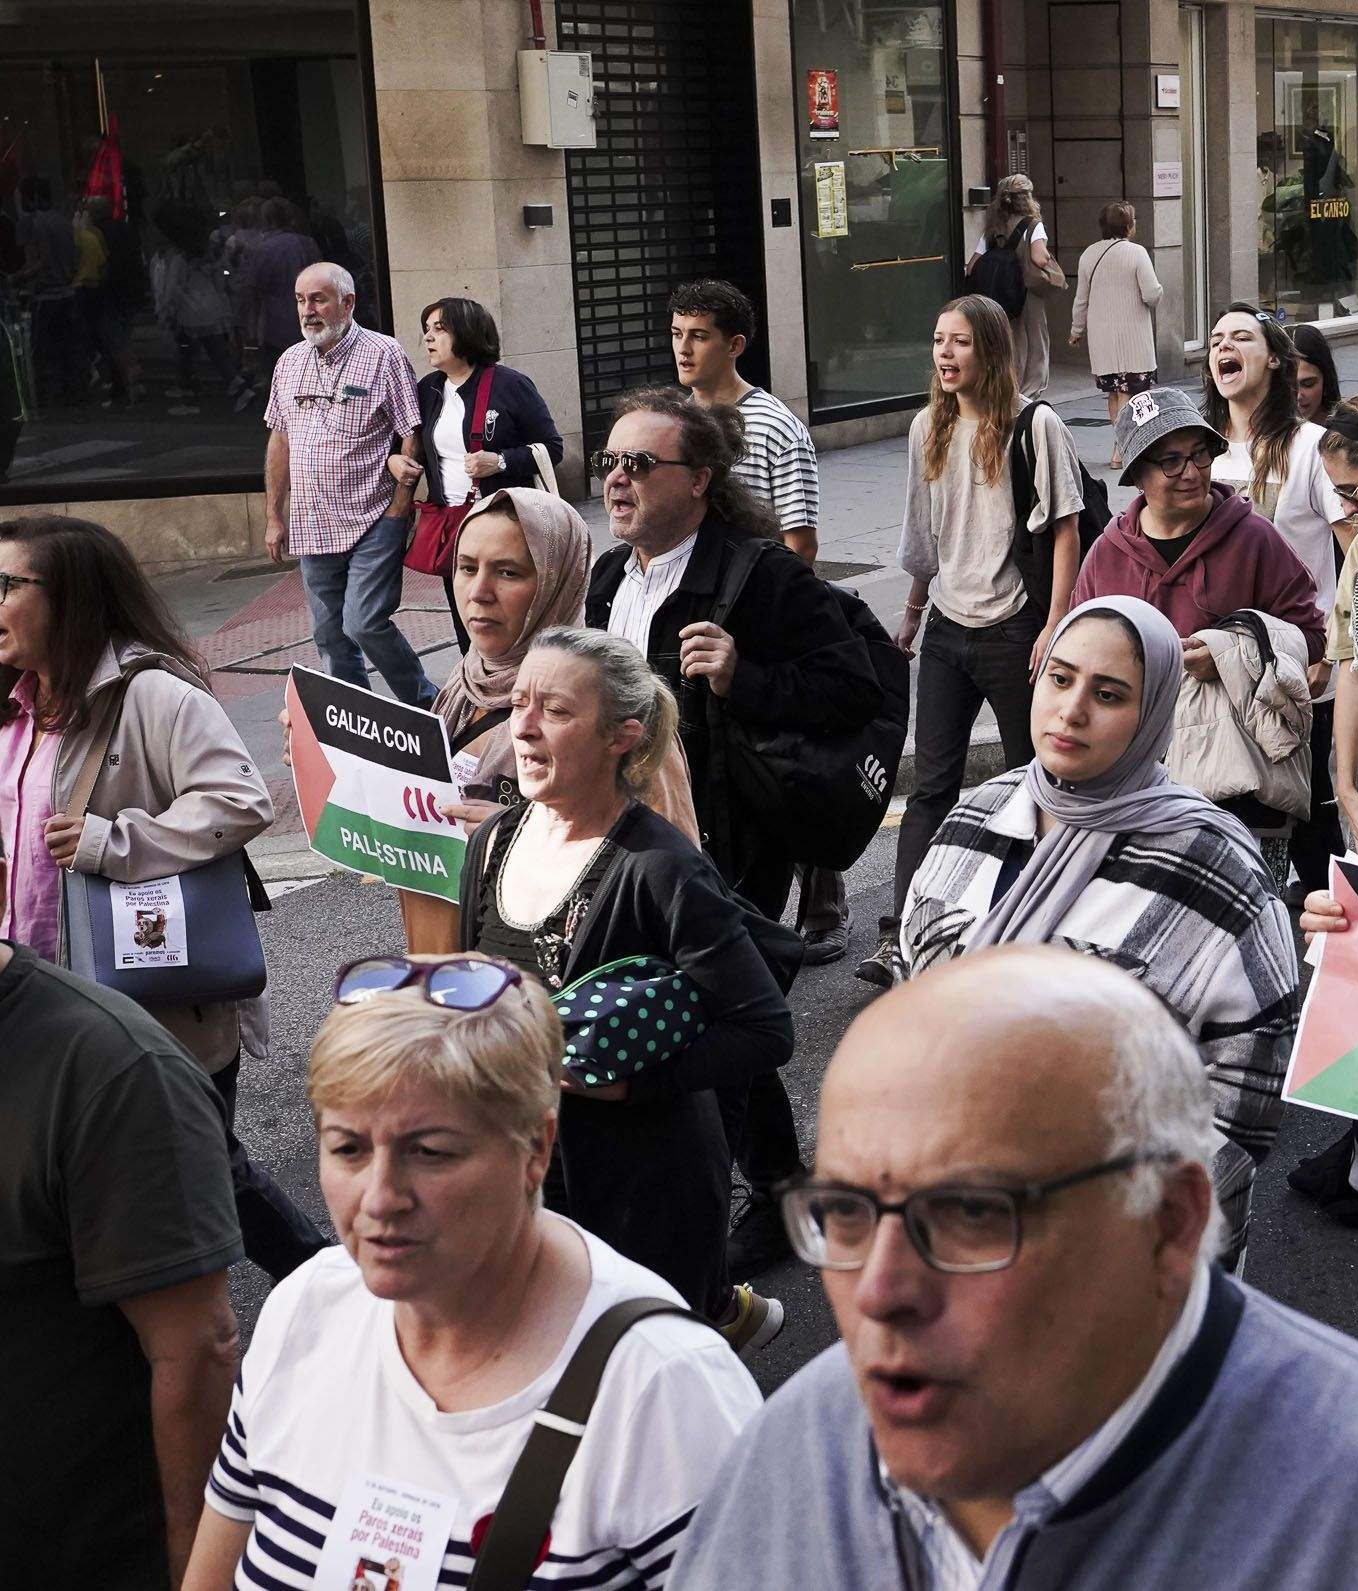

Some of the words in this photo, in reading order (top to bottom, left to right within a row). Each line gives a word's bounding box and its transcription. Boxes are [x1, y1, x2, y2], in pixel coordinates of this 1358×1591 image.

[1310, 203, 1322, 219] EL
[325, 704, 381, 744] GALIZA
[383, 725, 421, 756] CON
[864, 754, 887, 793] CIG
[339, 826, 449, 879] PALESTINA
[371, 1497, 383, 1512] Eu
[385, 1503, 409, 1520] apoio
[359, 1509, 389, 1531] Paros
[390, 1523, 424, 1543] xerais
[350, 1527, 370, 1542] por
[371, 1532, 422, 1560] Palestina
